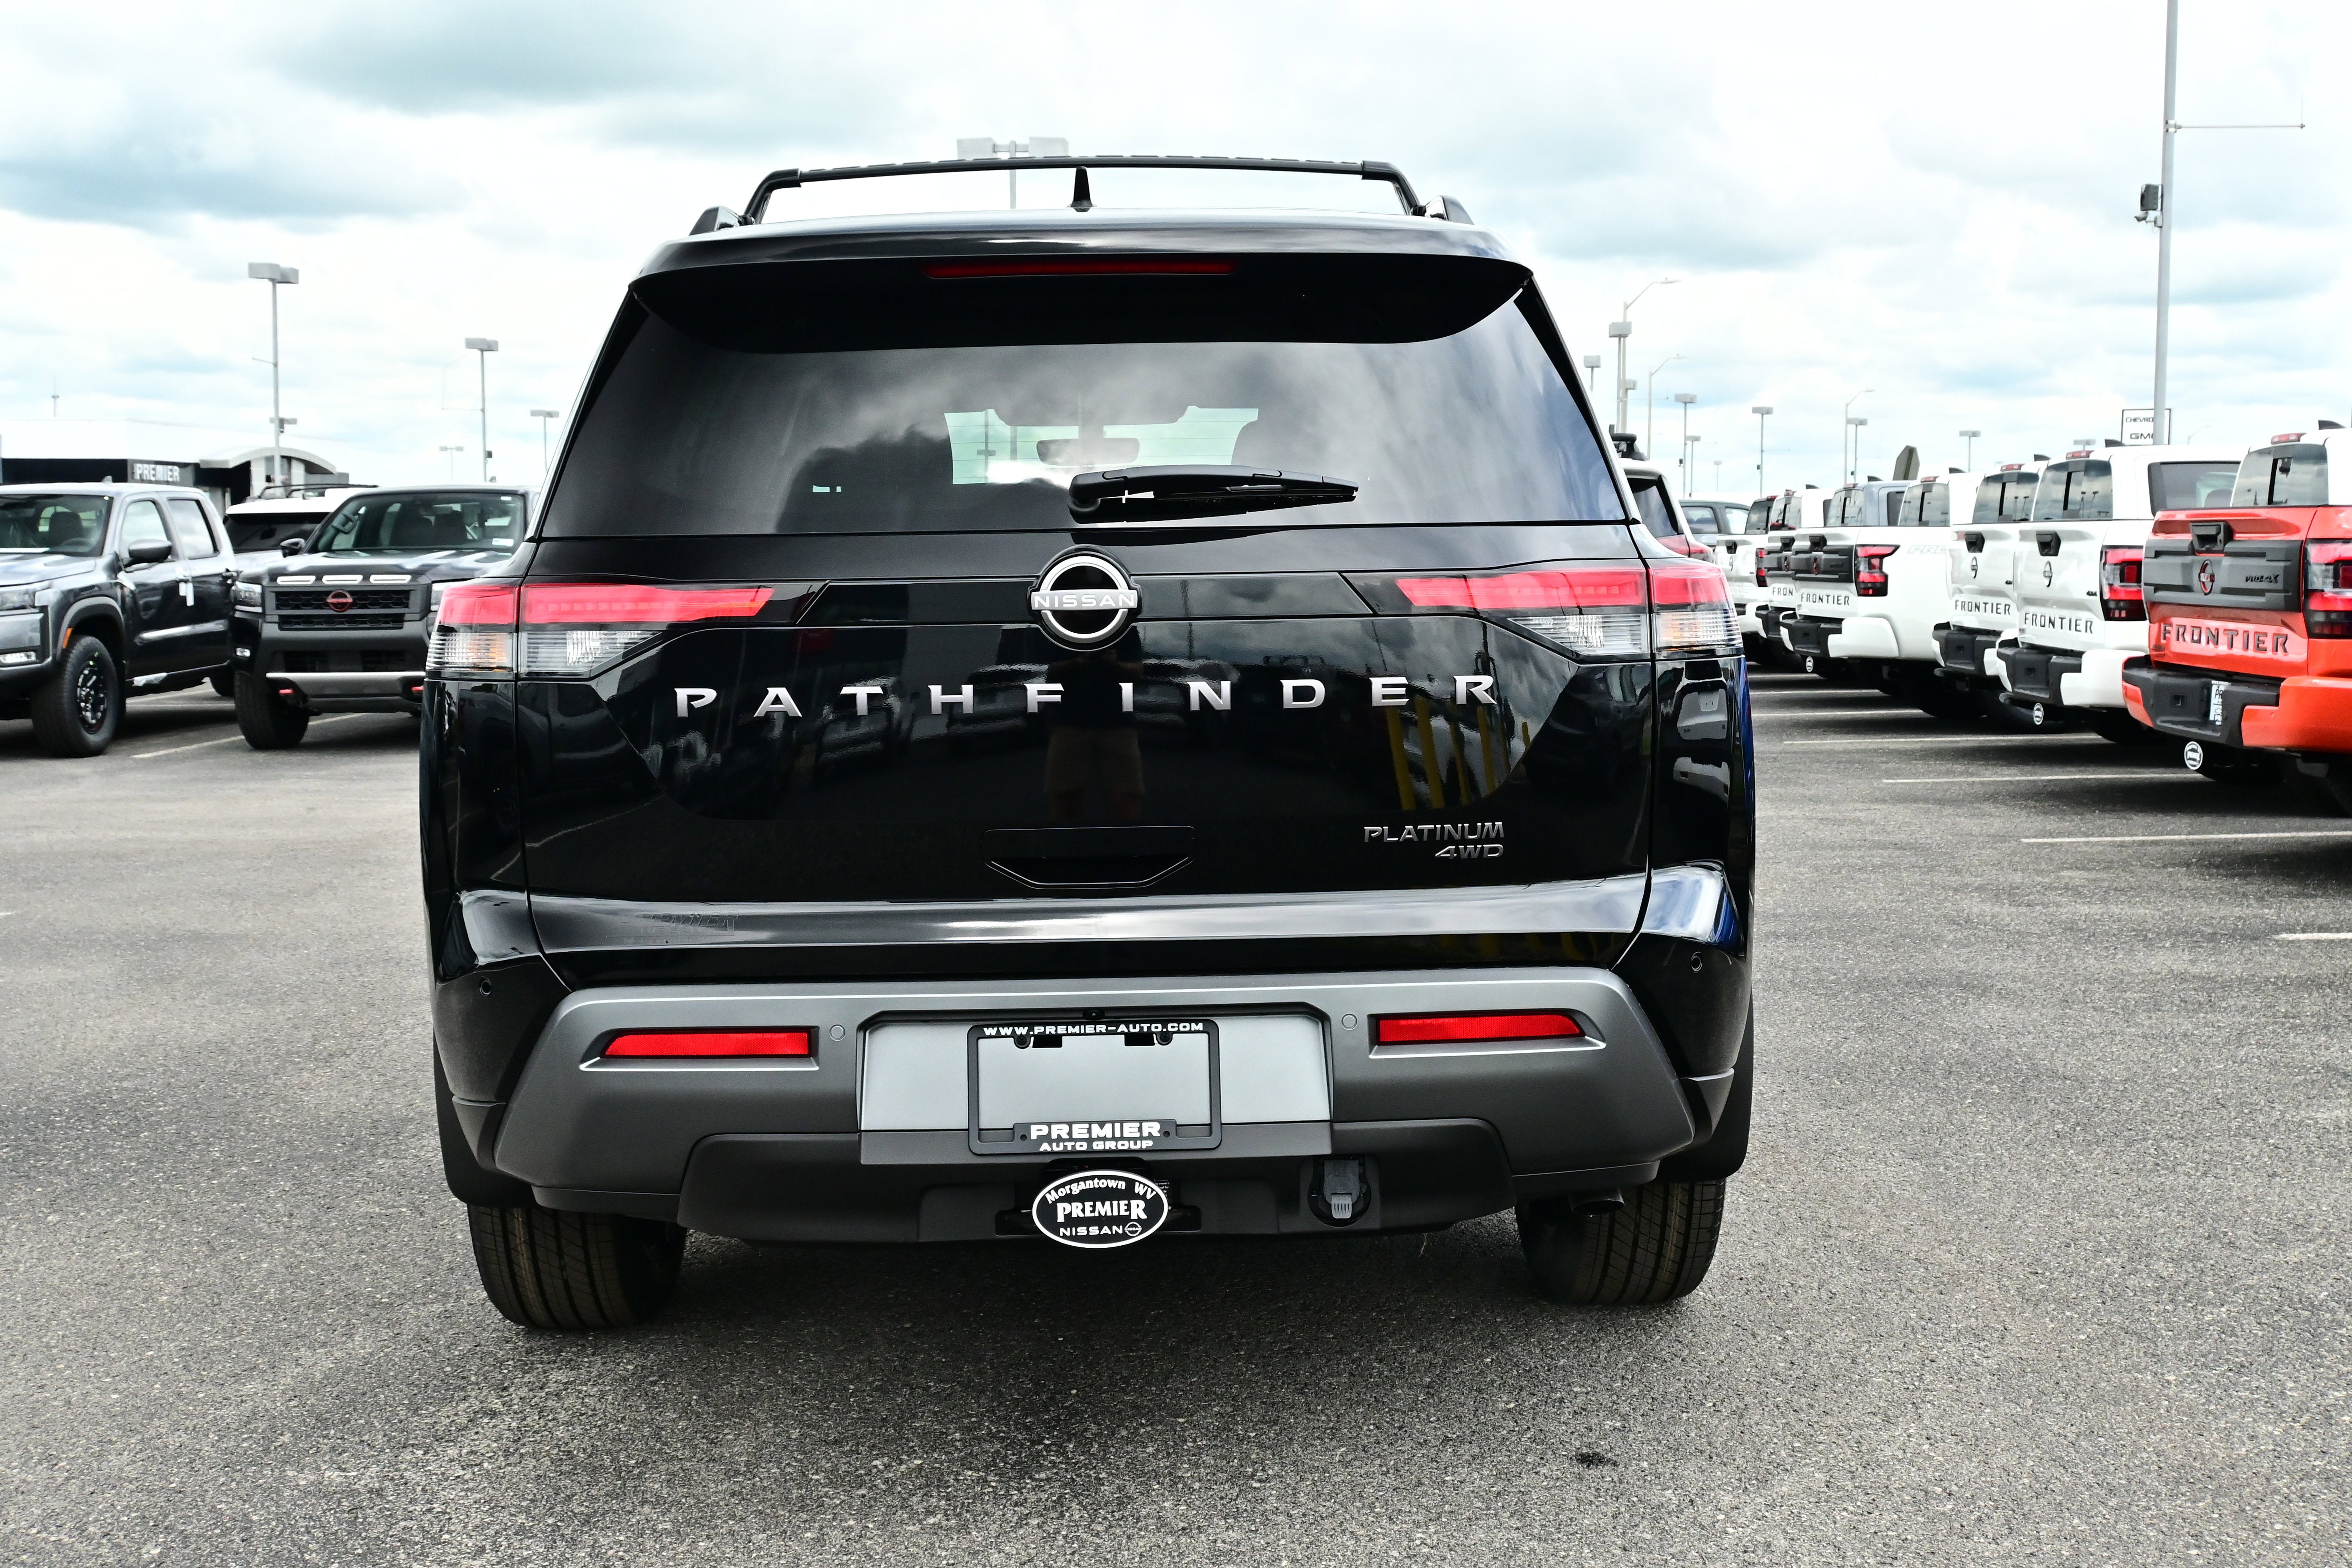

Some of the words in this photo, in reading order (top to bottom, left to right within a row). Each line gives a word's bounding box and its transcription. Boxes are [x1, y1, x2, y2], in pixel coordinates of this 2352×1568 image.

[134, 463, 180, 482] PREMIER
[1772, 587, 1794, 596] FRON
[1801, 593, 1850, 606] FRONTIER
[1034, 593, 1135, 608] NISSAN
[1955, 600, 2011, 615] FRONTIER
[2025, 612, 2093, 634] FRONTIER
[2161, 624, 2288, 653] FRONTIER
[674, 675, 1497, 718] PATHFINDER
[1364, 822, 1505, 842] PLATINUM
[1435, 844, 1504, 859] 4WD
[983, 1022, 1203, 1036] WWW.PREMIER-AUTO.COM
[1030, 1122, 1161, 1140] PREMIER
[1039, 1142, 1087, 1152] AUTO
[1092, 1140, 1153, 1150] GROUP
[1045, 1178, 1126, 1204] Morgantown
[1135, 1182, 1157, 1200] WV
[1056, 1200, 1148, 1222] PREMIER
[1060, 1225, 1123, 1236] NISSAN
